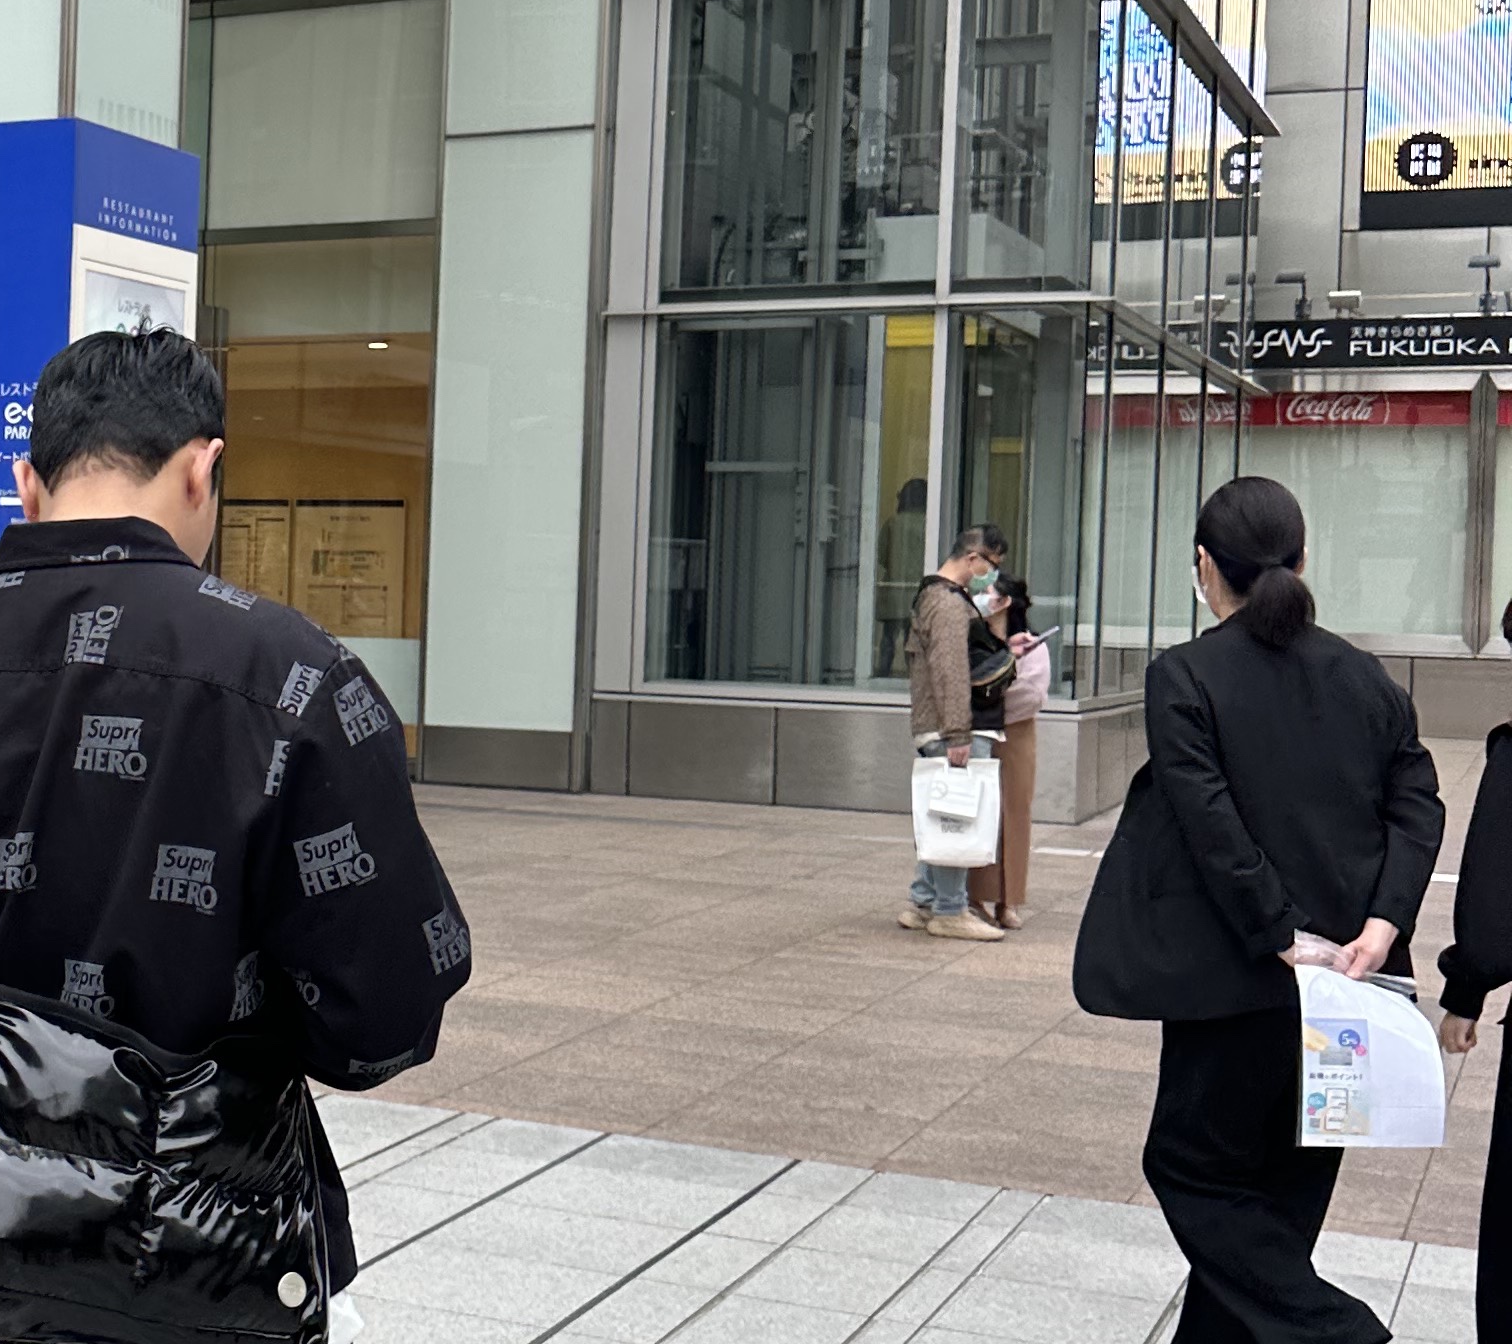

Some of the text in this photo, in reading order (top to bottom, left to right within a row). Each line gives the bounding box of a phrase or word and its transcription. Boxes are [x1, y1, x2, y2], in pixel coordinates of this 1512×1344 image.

[97, 211, 178, 242] INFORMATION
[102, 196, 175, 227] RESTAURANT
[1349, 338, 1500, 356] FUKUOKA
[74, 747, 148, 777] HERO
[299, 852, 376, 897] HERO
[149, 876, 218, 910] HERO
